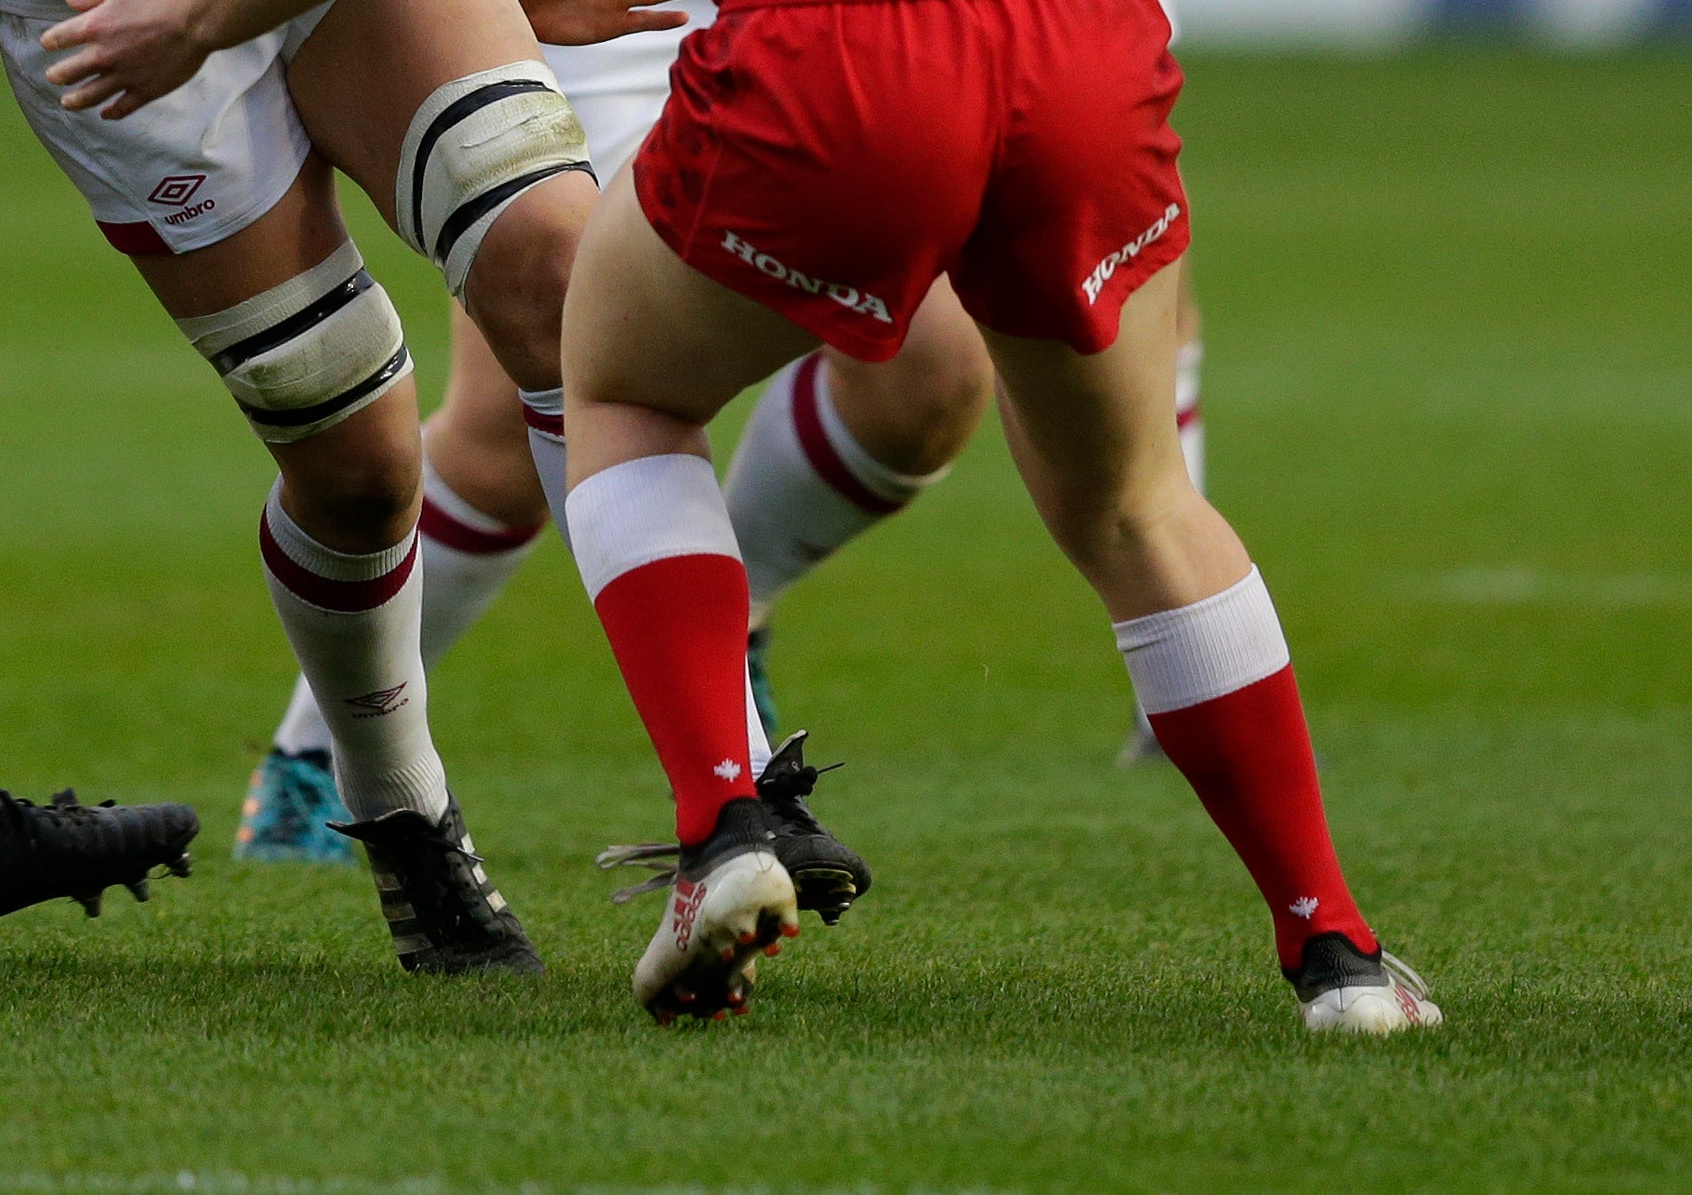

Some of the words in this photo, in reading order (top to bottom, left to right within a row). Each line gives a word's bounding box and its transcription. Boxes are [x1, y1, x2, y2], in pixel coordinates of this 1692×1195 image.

[164, 199, 216, 225] umbro
[721, 230, 894, 324] HONDA
[1081, 203, 1181, 305] HONDA
[675, 882, 708, 952] adidas
